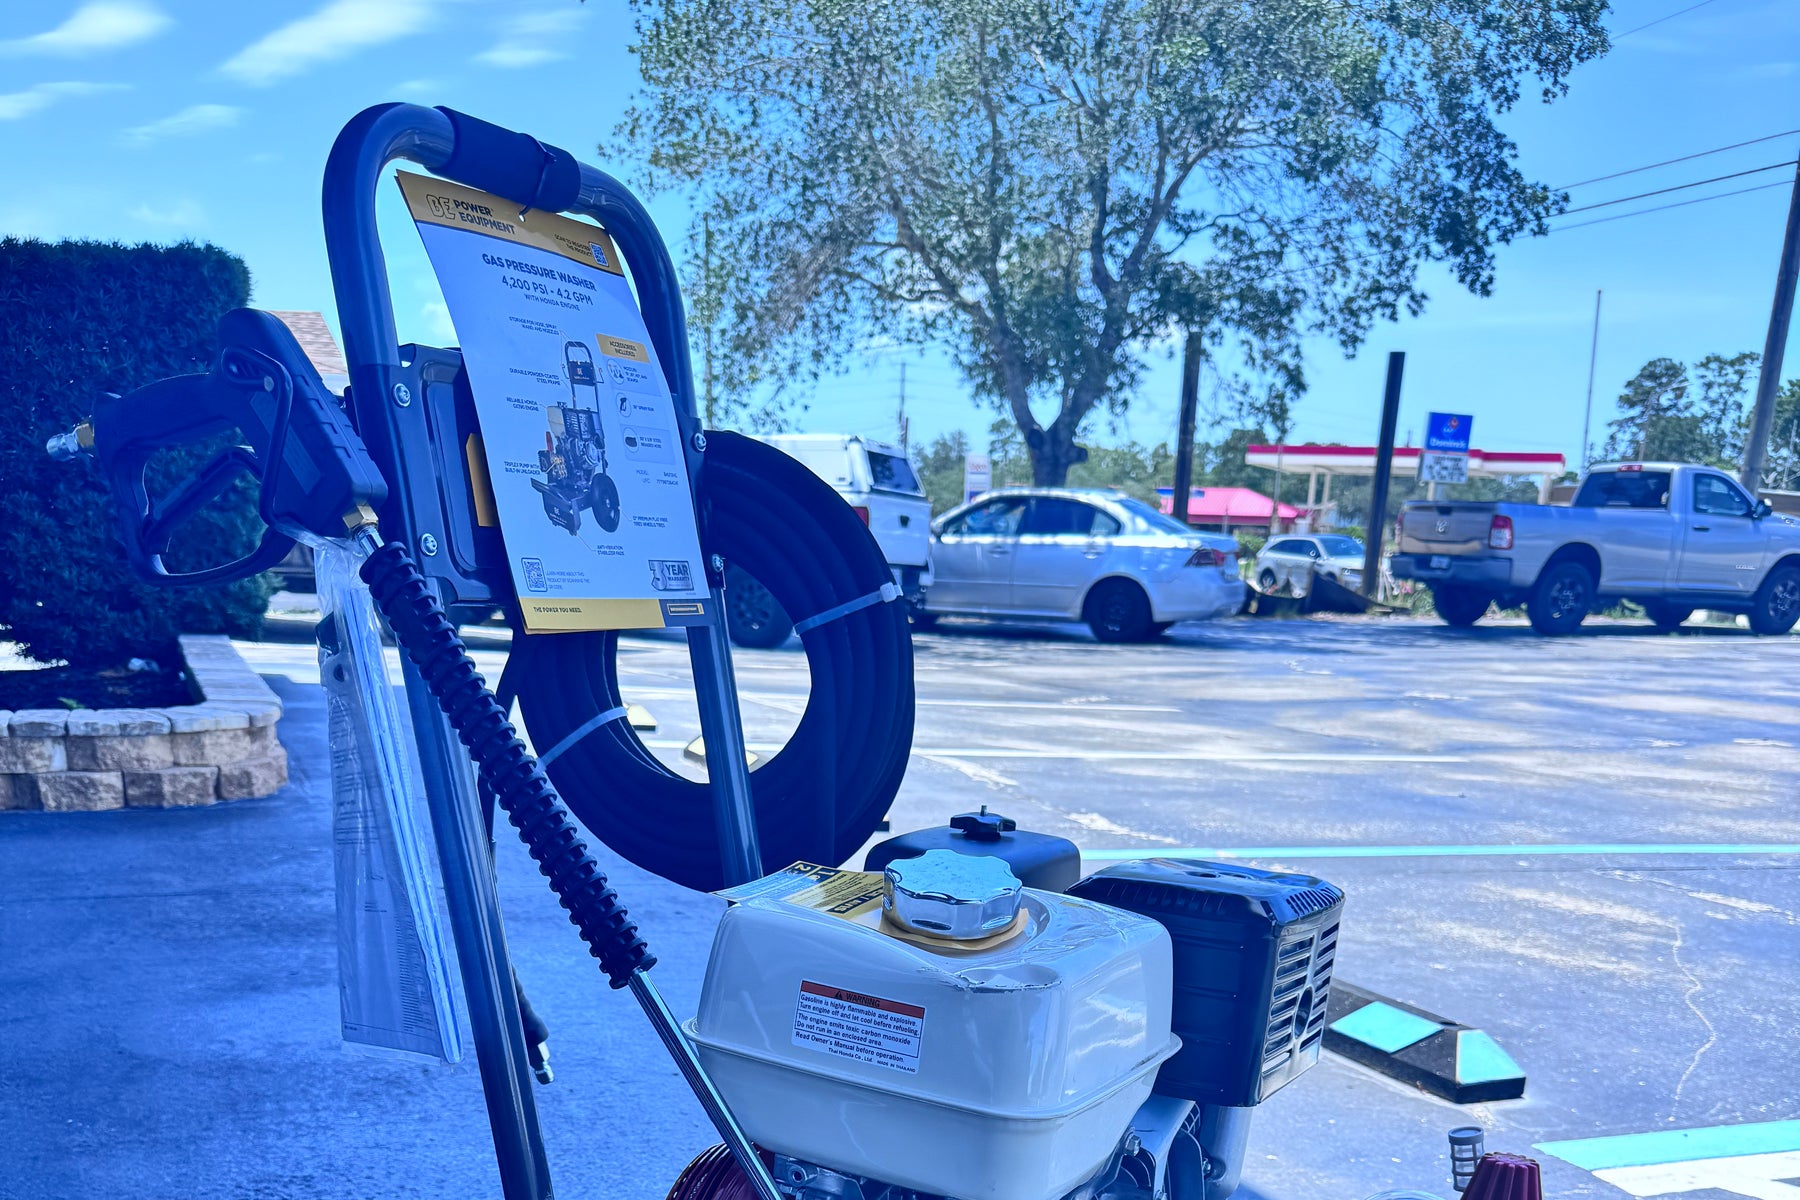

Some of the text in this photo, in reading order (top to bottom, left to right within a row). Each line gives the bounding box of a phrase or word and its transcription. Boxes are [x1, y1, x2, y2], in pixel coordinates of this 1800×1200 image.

[453, 199, 493, 217] POWER
[459, 212, 515, 235] EQUIPMENT
[482, 253, 597, 292] GAS PRESSURE WASHER
[502, 275, 530, 291] 4,200
[532, 282, 549, 295] PSI
[557, 288, 572, 301] 4.2
[573, 292, 594, 306] GPM
[665, 564, 689, 576] YEAR
[801, 993, 823, 1005] Gasoline
[830, 1001, 846, 1011] highly
[847, 1005, 876, 1017] flammable
[846, 992, 880, 1008] WARNING
[798, 1012, 808, 1020] The
[809, 1016, 828, 1026] engine
[829, 1021, 844, 1030] emits
[846, 1024, 860, 1034] toxic
[860, 1028, 881, 1039] carbon
[800, 1001, 811, 1009] Turn
[812, 1005, 830, 1014] engine
[873, 1020, 891, 1029] before
[892, 1024, 919, 1037] refueling.
[795, 1031, 810, 1041] Read
[811, 1035, 833, 1046] Owner's
[833, 1040, 855, 1051] Manual
[855, 1046, 875, 1056] before
[841, 1032, 867, 1043] enclosed
[838, 1050, 854, 1059] Honda
